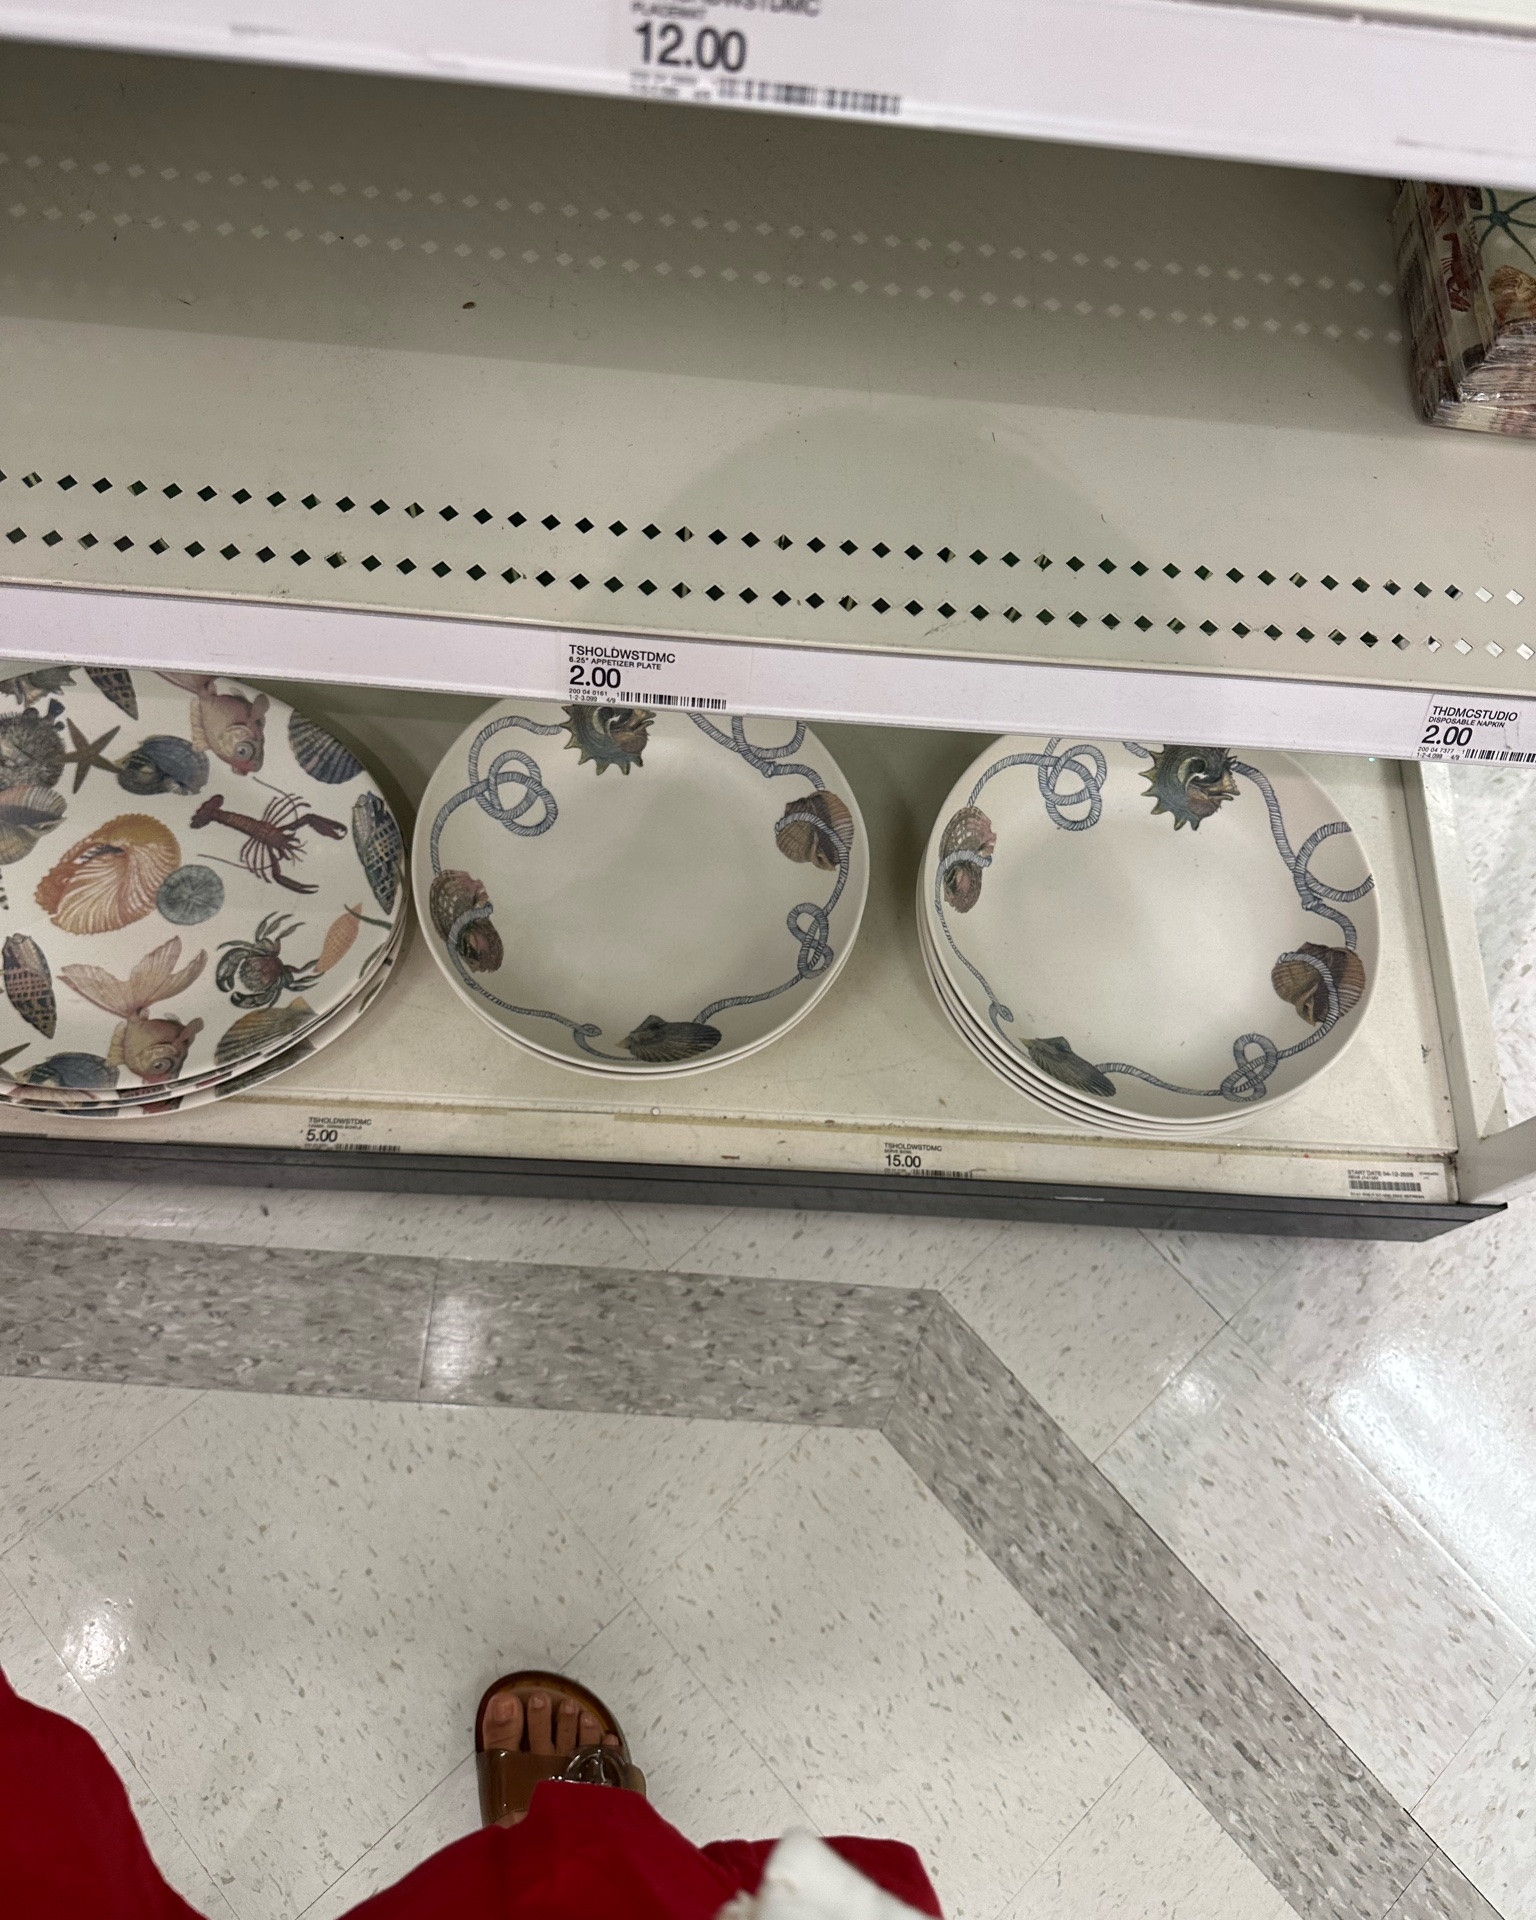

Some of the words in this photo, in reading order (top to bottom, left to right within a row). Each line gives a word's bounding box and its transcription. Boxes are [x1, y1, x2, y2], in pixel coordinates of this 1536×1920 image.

[634, 20, 748, 73] 12.00
[569, 644, 676, 664] TSHOLDWSTDMC
[591, 658, 635, 668] APPETIZER
[637, 662, 662, 671] PLATE
[570, 665, 621, 688] 2.00
[1432, 705, 1518, 722] THDMCSTUDIO
[1428, 716, 1476, 726] DISPOSABLE
[1476, 720, 1505, 728] NAPKIN
[1421, 725, 1473, 746] 2.00
[309, 1117, 372, 1126] TSHOLDWSTDMC
[306, 1129, 338, 1142] 5.00
[884, 1142, 942, 1152] TSHOLDWSTDMC
[885, 1154, 922, 1168] 15.00
